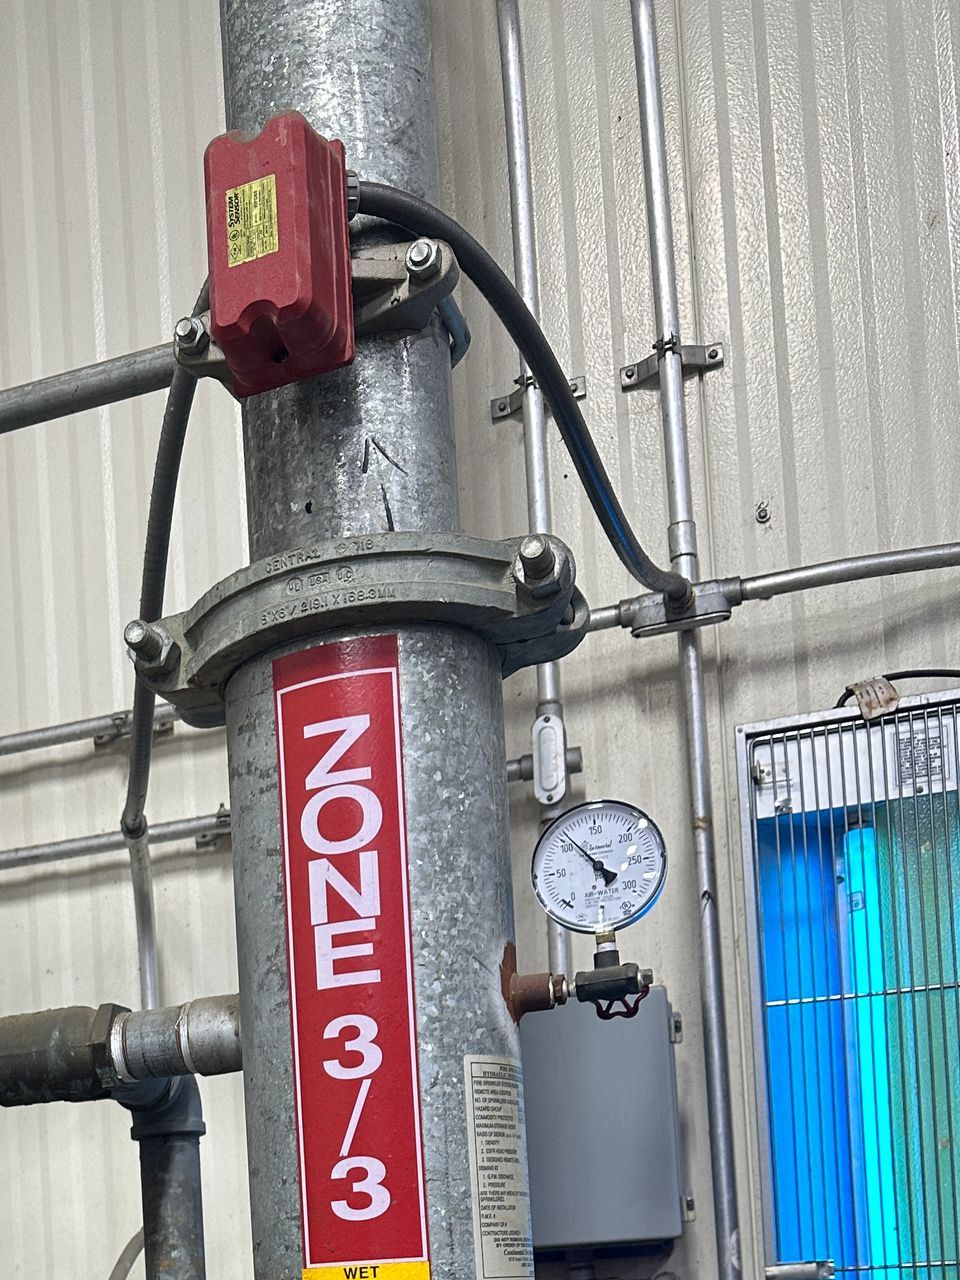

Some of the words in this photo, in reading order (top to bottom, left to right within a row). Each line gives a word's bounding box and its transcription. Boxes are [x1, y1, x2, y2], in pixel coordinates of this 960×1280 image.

[265, 548, 321, 573] CENTRAL
[589, 825, 602, 835] 150
[618, 832, 633, 844] 200
[300, 713, 383, 990] ZONE
[561, 843, 573, 853] 100
[627, 855, 642, 866] 250
[556, 868, 566, 878] 50
[622, 880, 637, 890] 300
[570, 892, 576, 901] 0
[584, 888, 619, 898] AIR-WATER
[343, 1266, 380, 1280] WET
